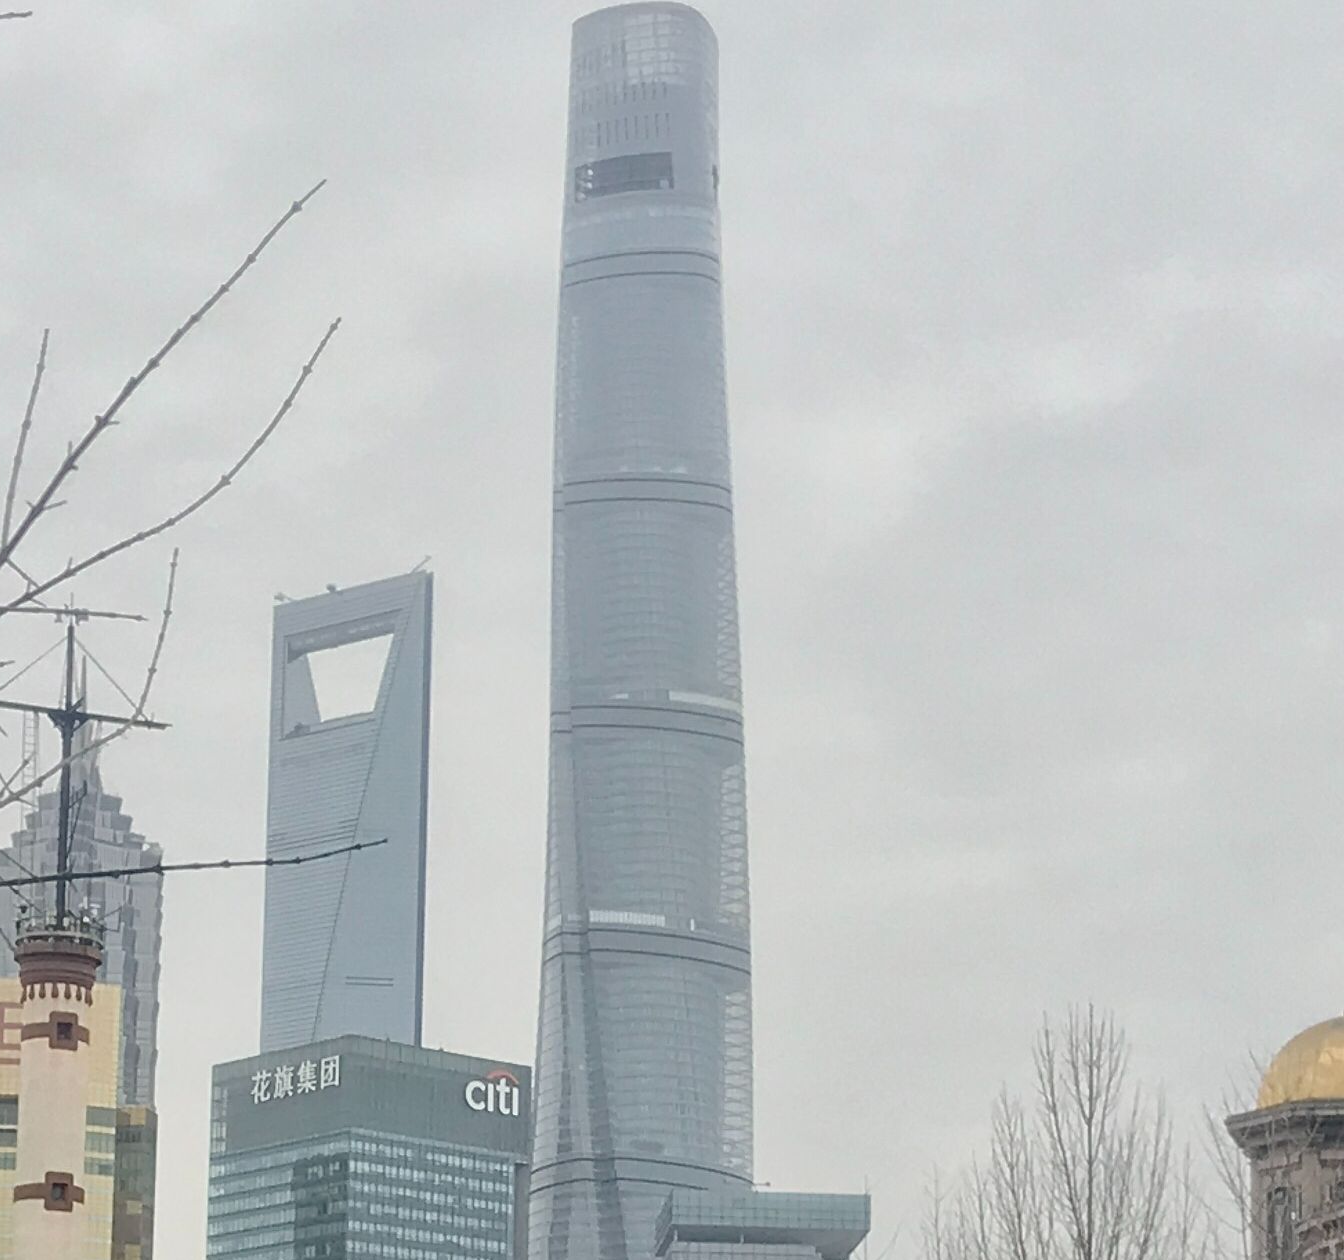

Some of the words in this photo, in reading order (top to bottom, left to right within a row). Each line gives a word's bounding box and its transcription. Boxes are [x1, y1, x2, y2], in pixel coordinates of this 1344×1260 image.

[250, 1054, 340, 1105] 花旗集团
[465, 1077, 519, 1116] citi
